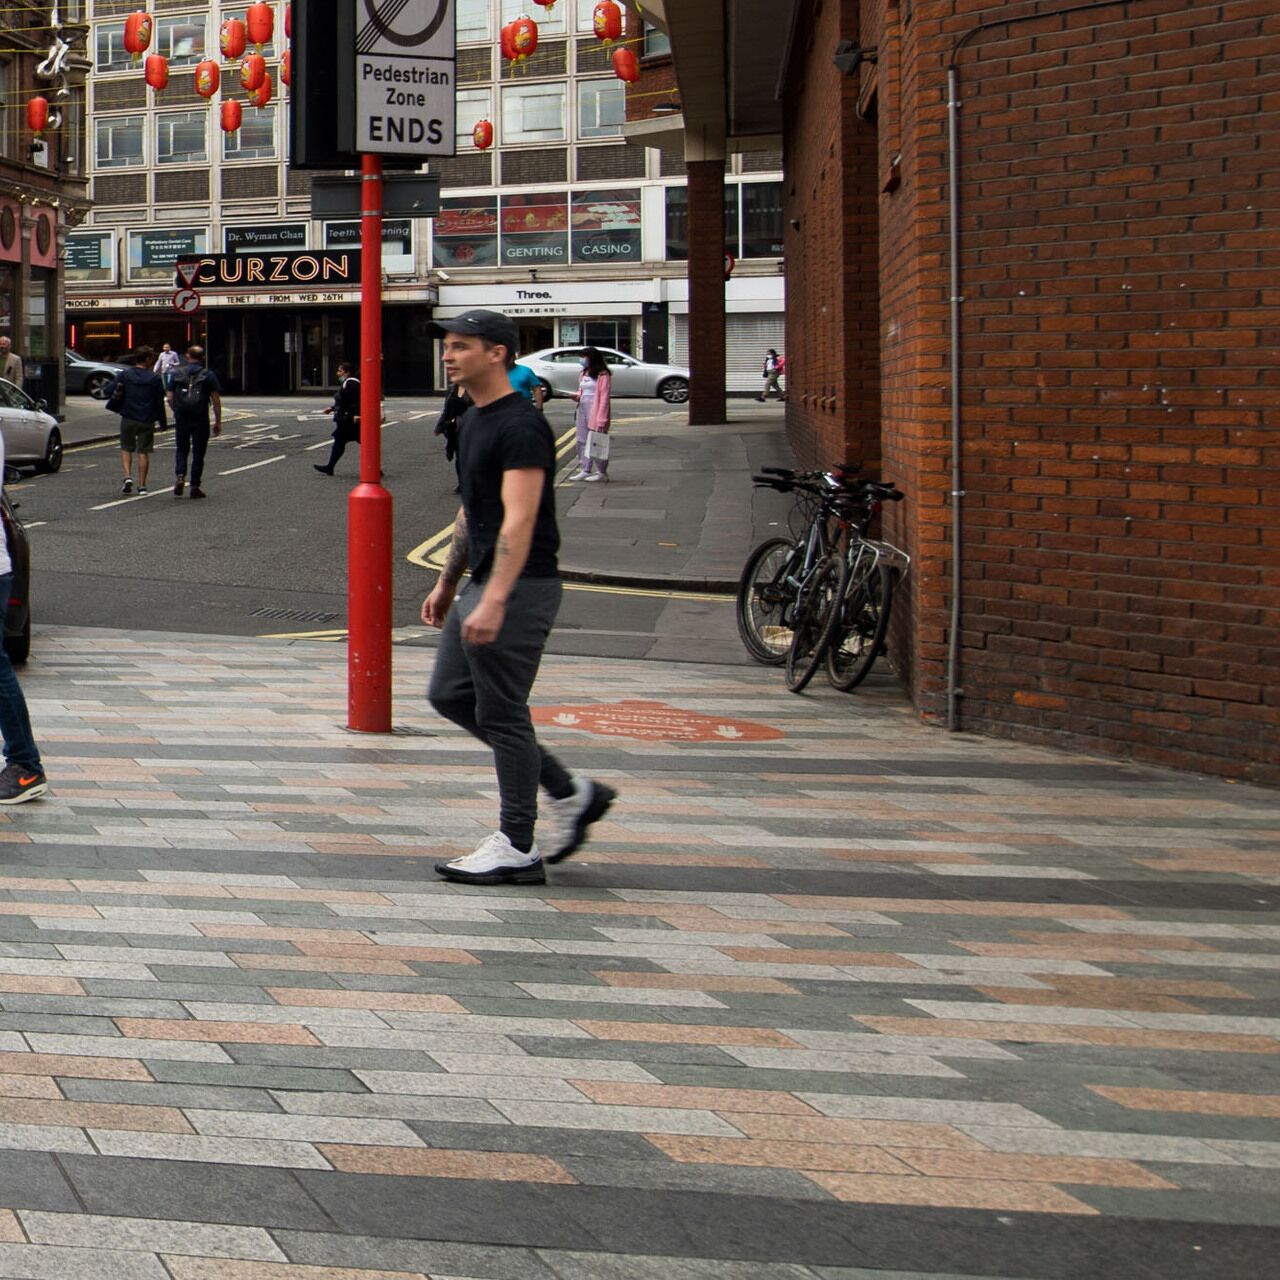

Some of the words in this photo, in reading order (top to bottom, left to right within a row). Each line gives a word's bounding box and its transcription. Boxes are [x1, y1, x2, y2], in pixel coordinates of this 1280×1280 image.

[363, 63, 449, 85] Pedestrian
[386, 87, 425, 106] Zone
[369, 116, 443, 145] ENDS
[228, 232, 243, 242] Dr.
[246, 231, 278, 243] Wyman
[280, 230, 304, 240] Chan
[329, 228, 356, 238] Teeth
[506, 246, 564, 258] GENTING
[582, 243, 632, 255] CASINO
[198, 255, 349, 283] CURZON
[226, 295, 250, 304] TENET
[269, 294, 290, 303] FROM
[299, 293, 318, 302] WED
[322, 293, 344, 301] 26TH
[516, 290, 552, 299] Three.
[135, 298, 174, 306] BABYTEET
